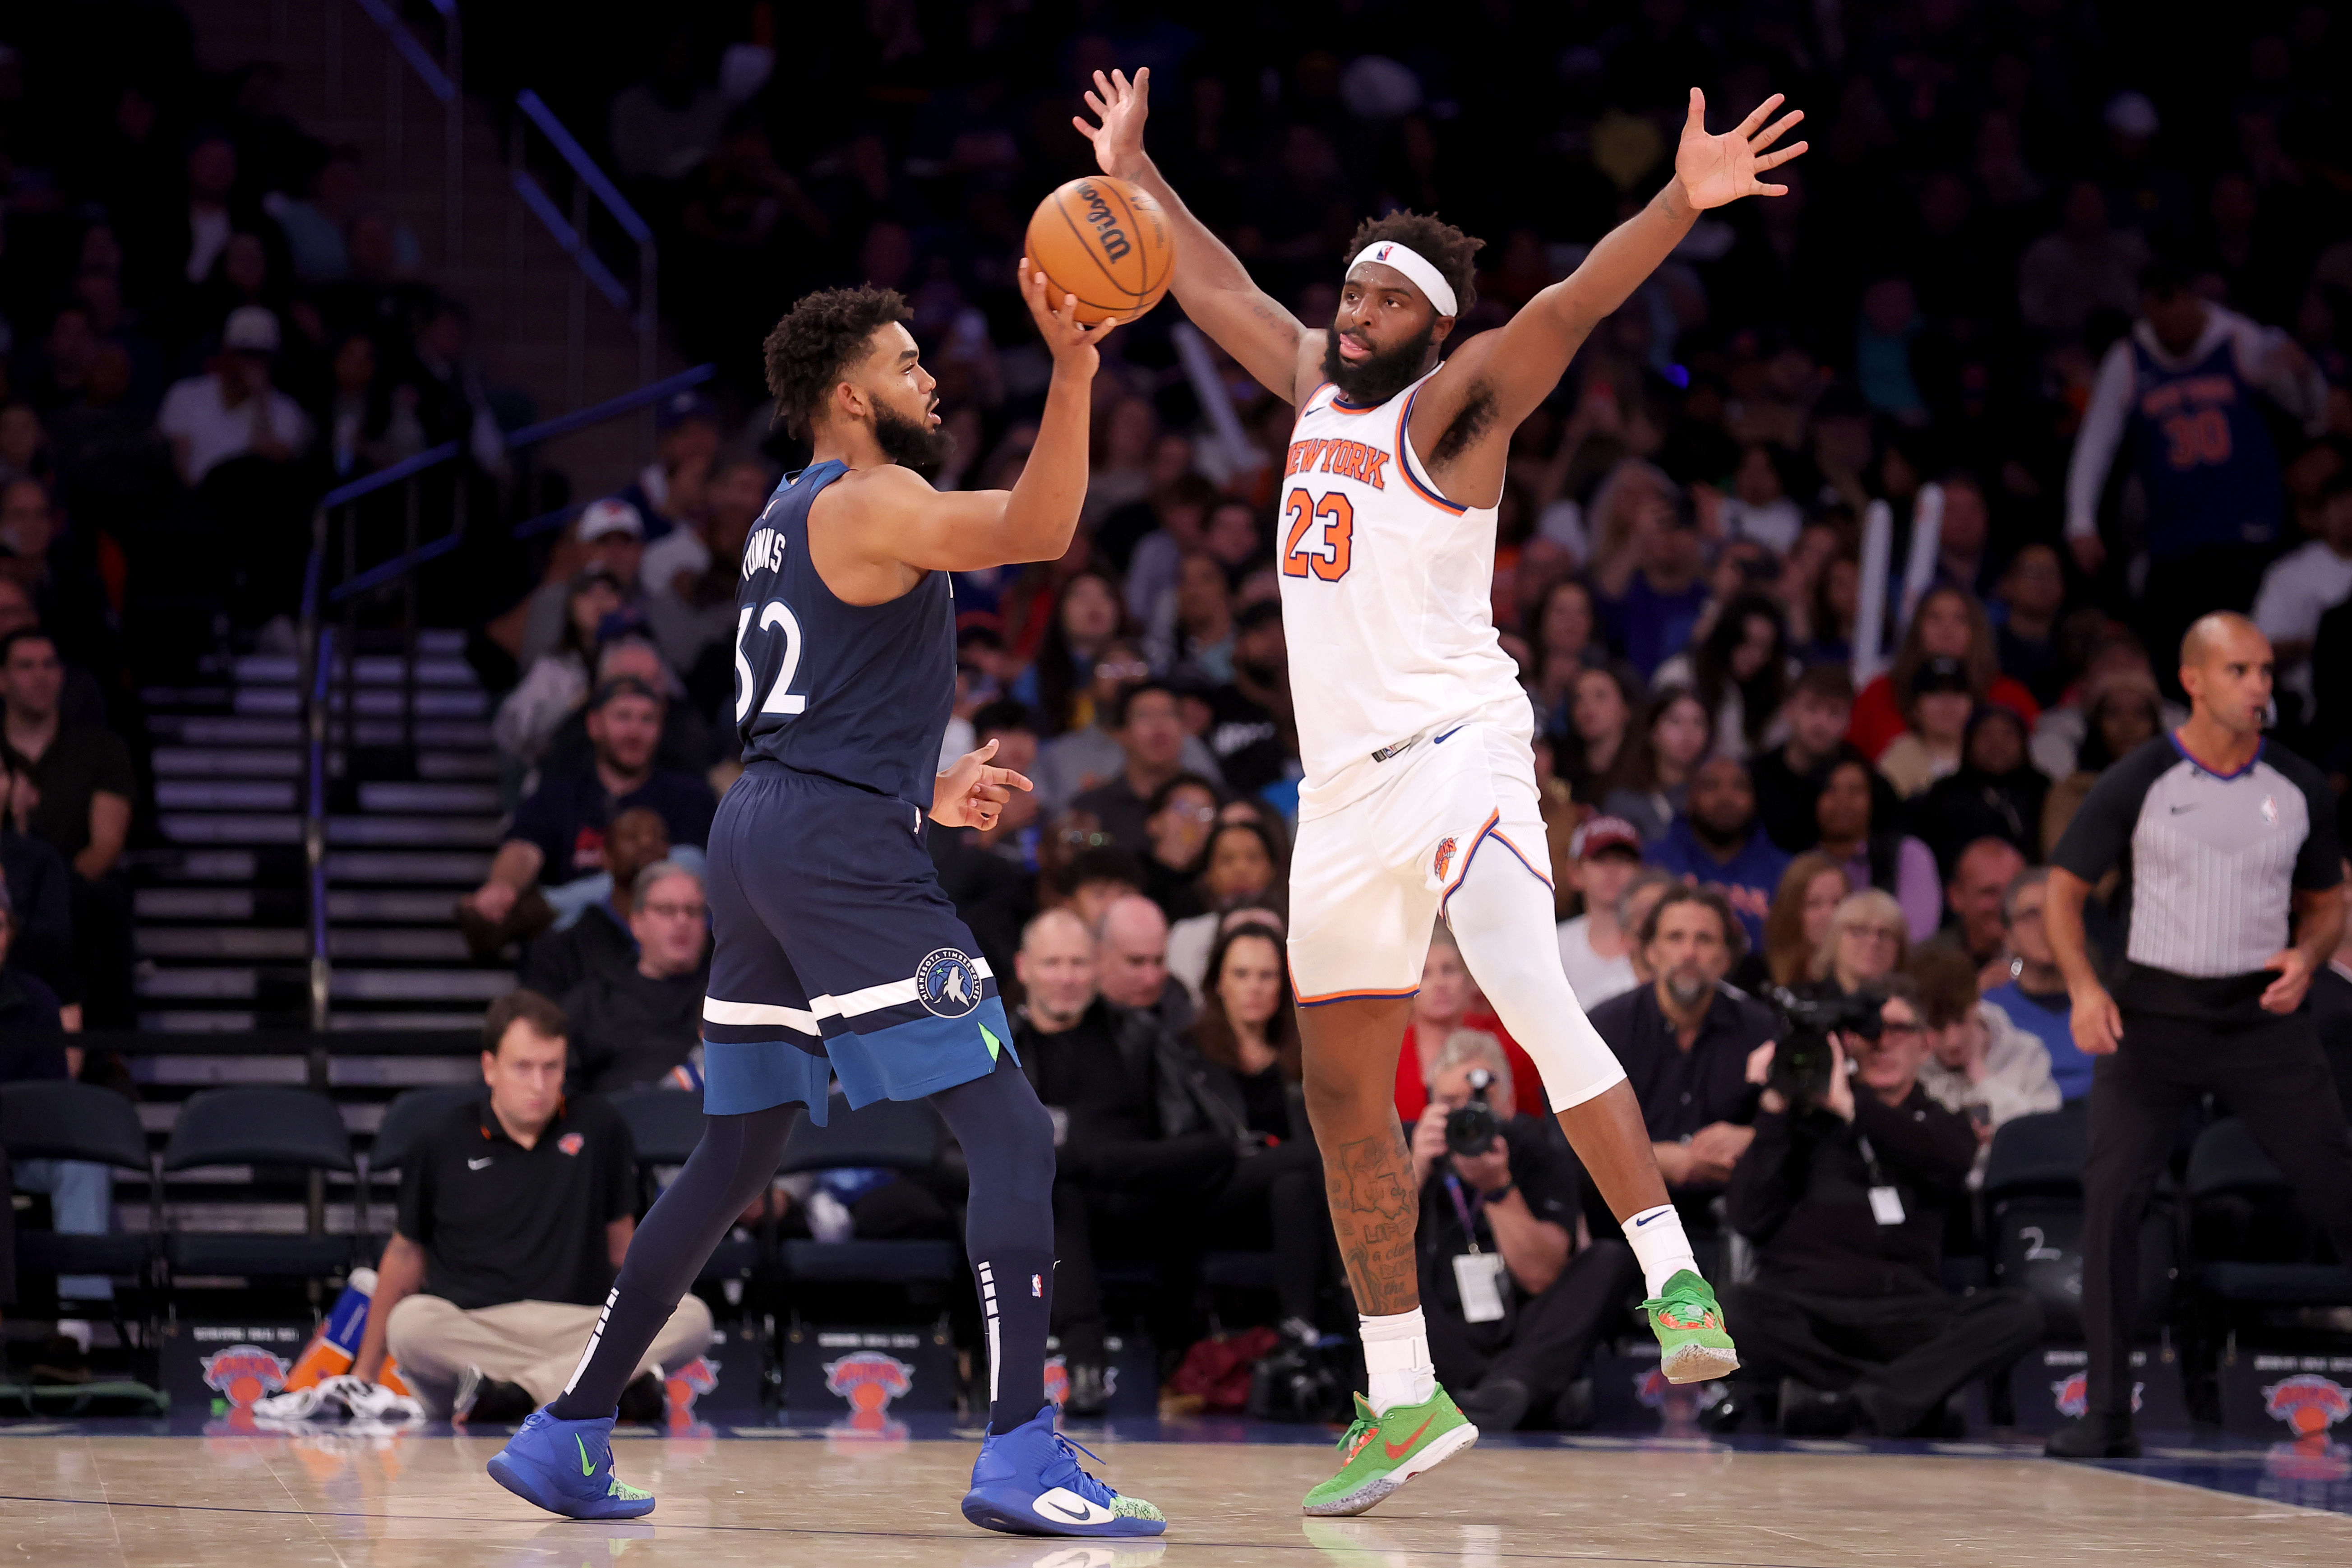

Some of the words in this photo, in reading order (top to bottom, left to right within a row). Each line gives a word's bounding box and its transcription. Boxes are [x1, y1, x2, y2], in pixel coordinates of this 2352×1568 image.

[1073, 181, 1131, 264] Wilson
[1284, 438, 1329, 479] NEW
[1320, 438, 1391, 491] YORK
[1284, 487, 1354, 583] 23
[919, 954, 940, 1000] MINNESOTA
[943, 951, 980, 1000] TIMBERWOLVES
[2019, 1226, 2062, 1261] 2
